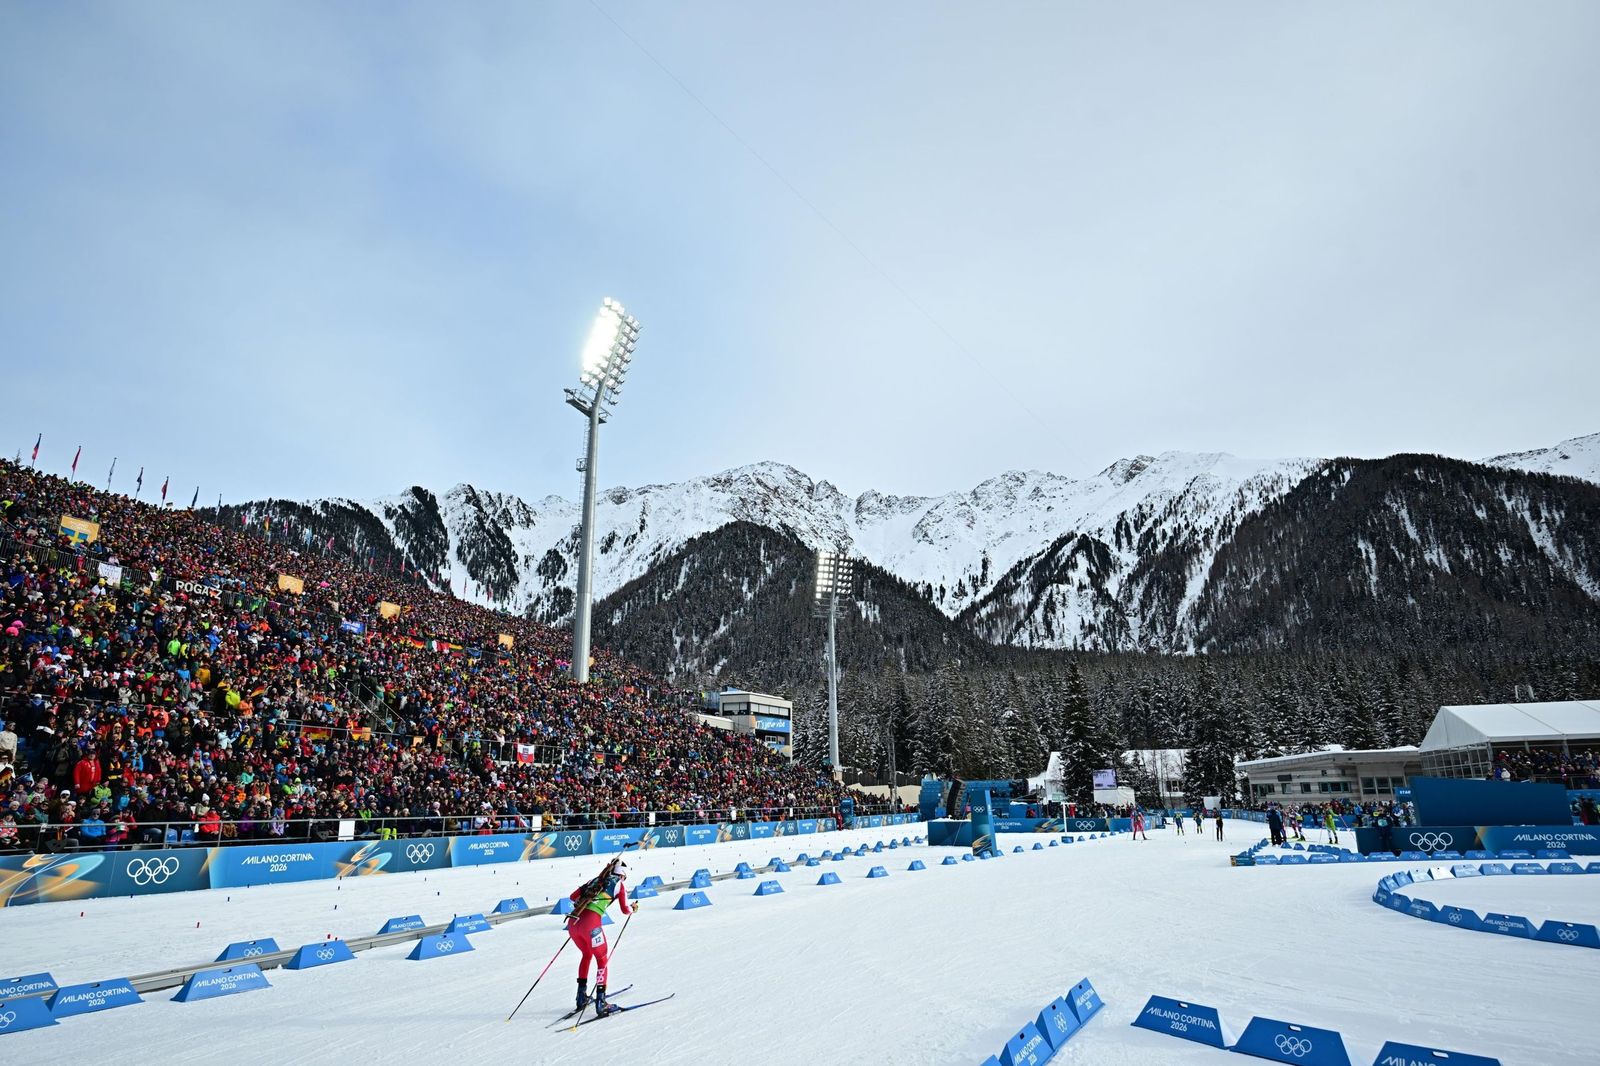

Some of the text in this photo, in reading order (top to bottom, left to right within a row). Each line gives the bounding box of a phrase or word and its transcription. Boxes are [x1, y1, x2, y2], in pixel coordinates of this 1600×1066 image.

[1513, 833, 1598, 841] MILANO CORTINA
[468, 841, 510, 850] MILANO CORTINA
[241, 852, 314, 865] MILANO CORTINA
[269, 863, 287, 872] 2026
[1504, 921, 1525, 929] CORTINA
[194, 971, 260, 988] MILANO CORTINA
[0, 981, 54, 995] ANO CORTINA
[220, 982, 237, 990] 2026
[59, 986, 131, 1005] MILANO CORTINA
[1146, 1006, 1217, 1030] MILANO CORTINA
[1170, 1021, 1188, 1032] 2026
[1381, 1056, 1437, 1066] MILA
